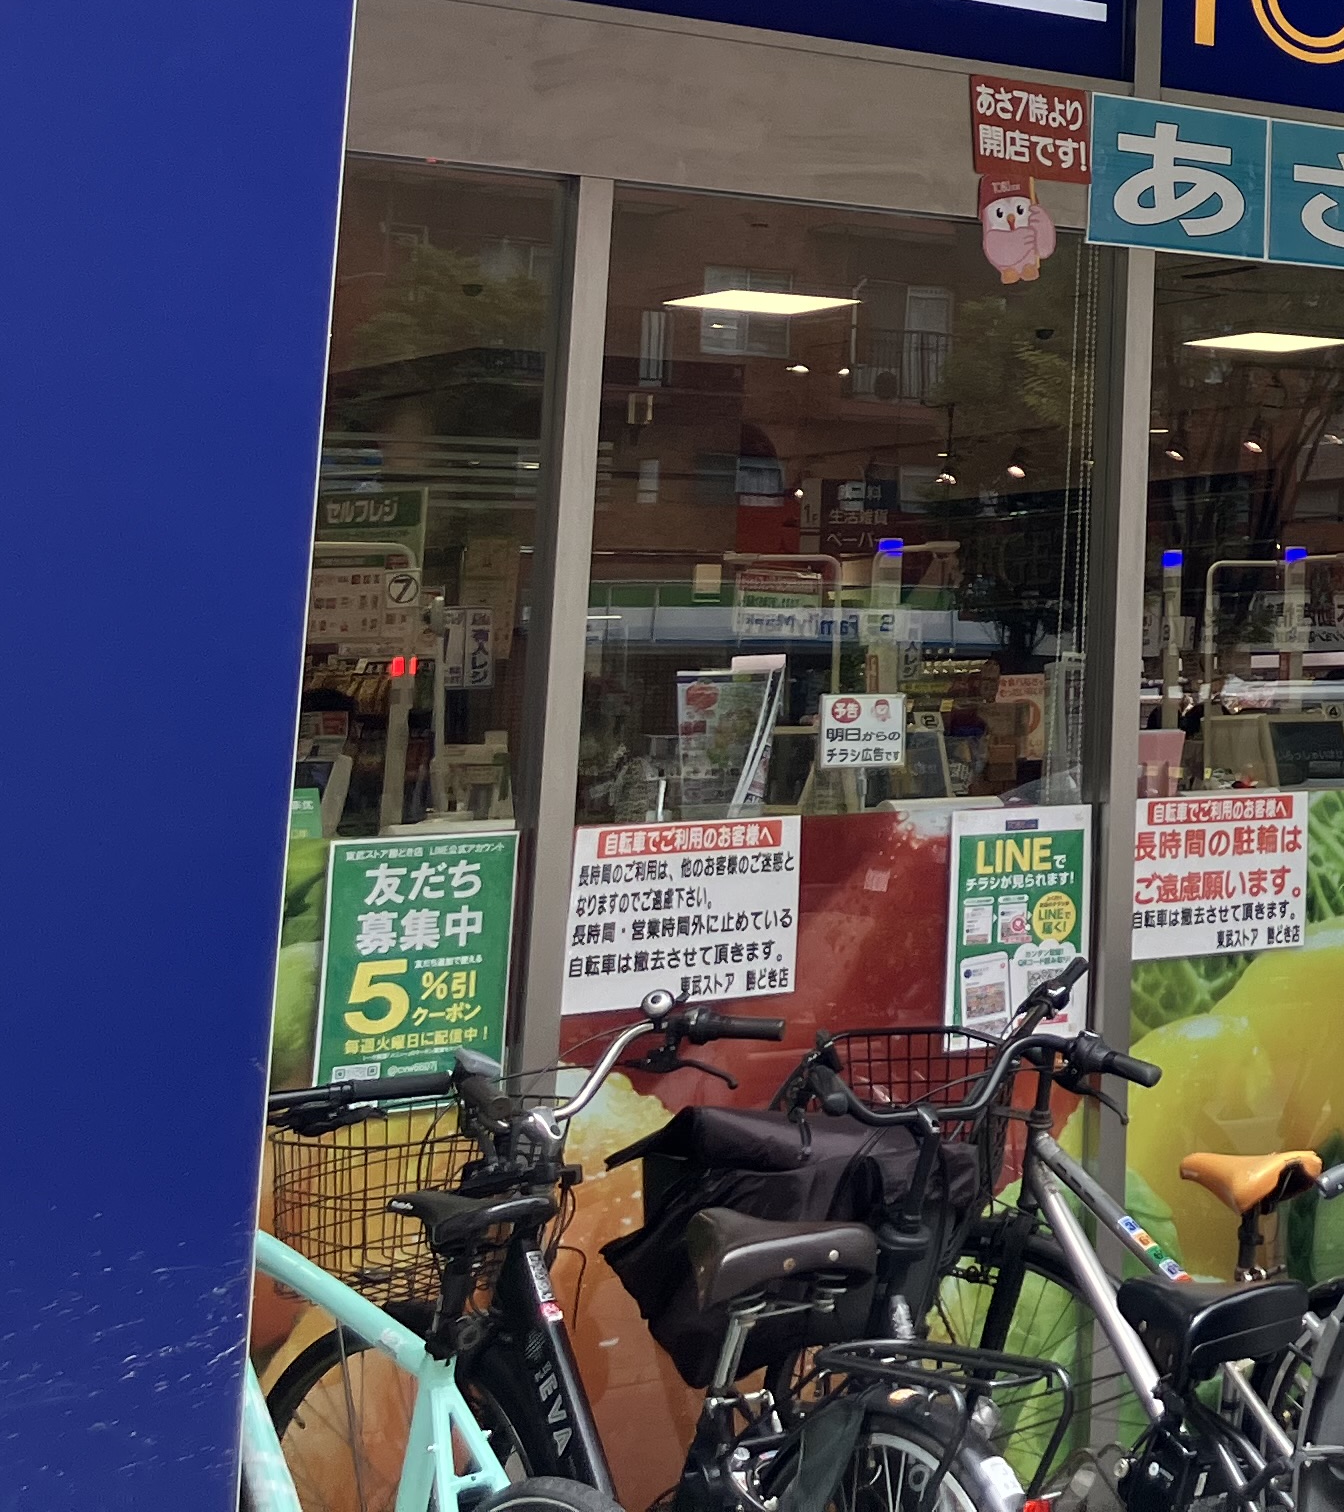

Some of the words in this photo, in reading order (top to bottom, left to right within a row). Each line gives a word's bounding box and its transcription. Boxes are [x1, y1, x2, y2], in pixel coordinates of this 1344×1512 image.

[976, 84, 1083, 131] あさ7時より
[979, 124, 1087, 172] 開店です!
[834, 702, 859, 718] 予告
[826, 727, 900, 742] 明日からの
[826, 746, 900, 763] チラシ広告です
[1153, 798, 1287, 823] 自転車でご利用のお客様へ
[604, 824, 774, 856] 自転車でご利用のお客様へ
[976, 836, 1067, 875] LINEで
[1135, 824, 1302, 861] 長時間の駐輪は
[364, 860, 482, 906] 友だち
[578, 851, 795, 887] 長時間のご利用は、他のお客様のご迷惑と
[966, 871, 1075, 892] チラシが見られます!
[1135, 865, 1301, 904] ご遠慮願います。
[575, 886, 712, 917] なりますのでご遠慮下さい。
[1133, 900, 1295, 929] 自転車は撤去させて頂きます。
[356, 905, 483, 955] 募集中
[572, 908, 793, 946] 長時間・営業時間外に止めている
[568, 940, 783, 978] 自転車は撤去させて頂きます。
[344, 958, 410, 1035] 5
[412, 1002, 481, 1027] クーポン
